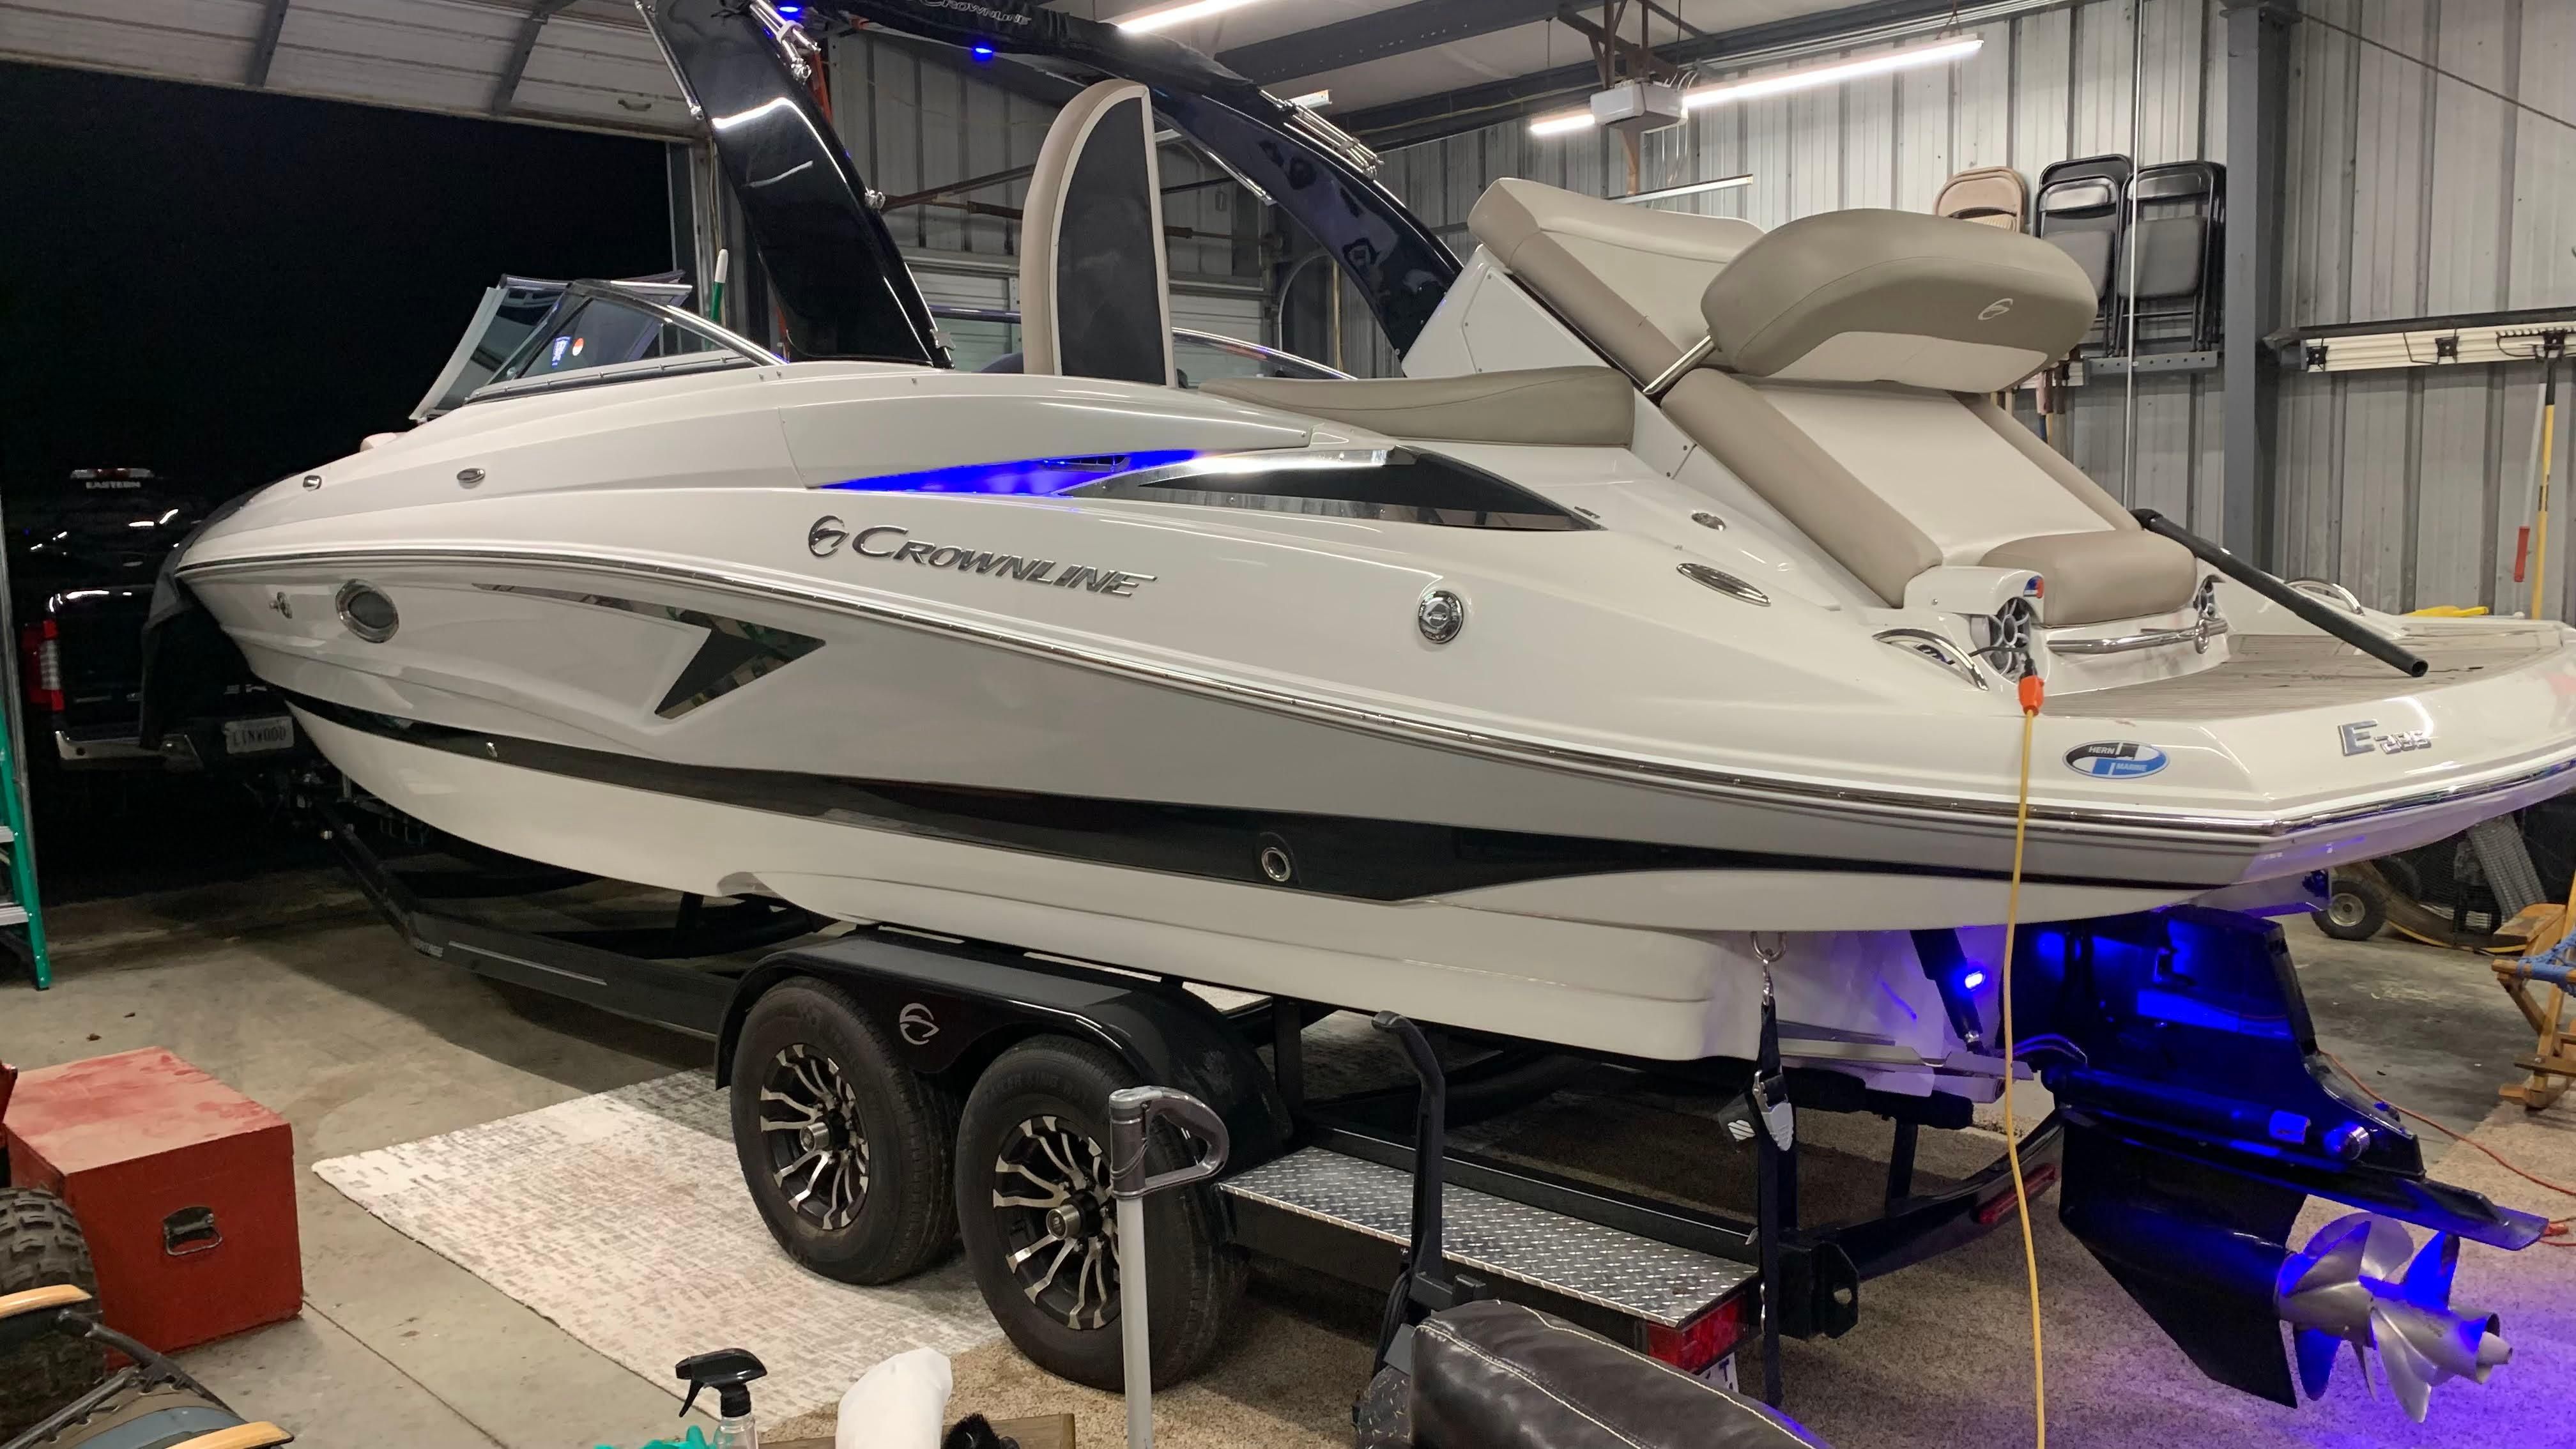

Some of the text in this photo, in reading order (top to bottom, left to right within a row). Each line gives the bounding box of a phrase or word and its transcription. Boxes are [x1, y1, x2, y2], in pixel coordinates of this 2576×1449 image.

[852, 525, 1158, 598] CROWNLINE
[2088, 746, 2115, 755] HERN
[2115, 762, 2147, 772] MARINE
